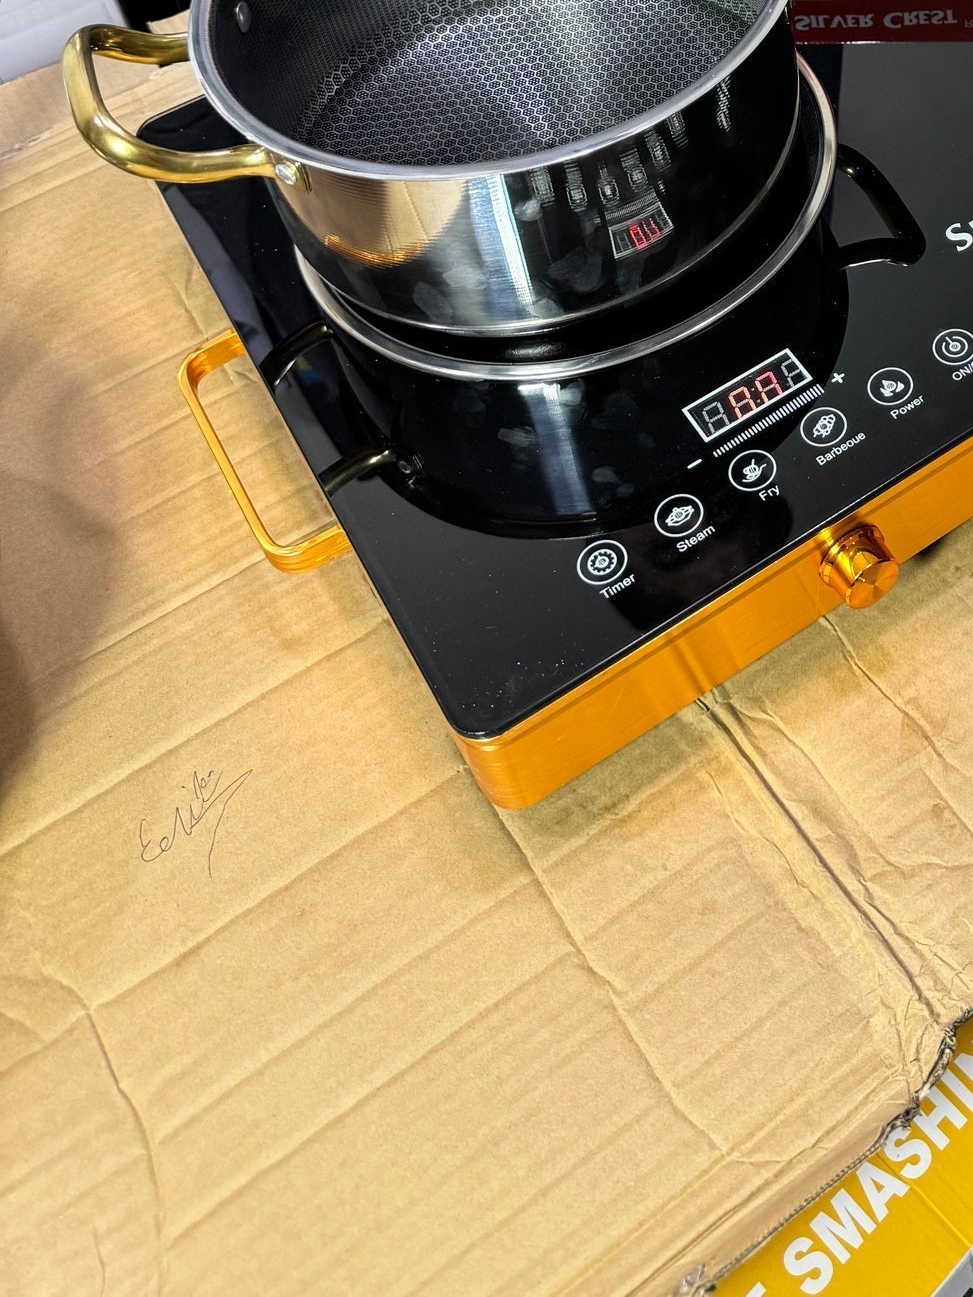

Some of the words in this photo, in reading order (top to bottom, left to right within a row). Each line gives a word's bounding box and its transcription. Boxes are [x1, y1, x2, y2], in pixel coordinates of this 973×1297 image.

[889, 393, 926, 421] Power
[758, 484, 781, 503] Fry
[675, 524, 716, 554] Steam
[599, 573, 638, 601] Timer
